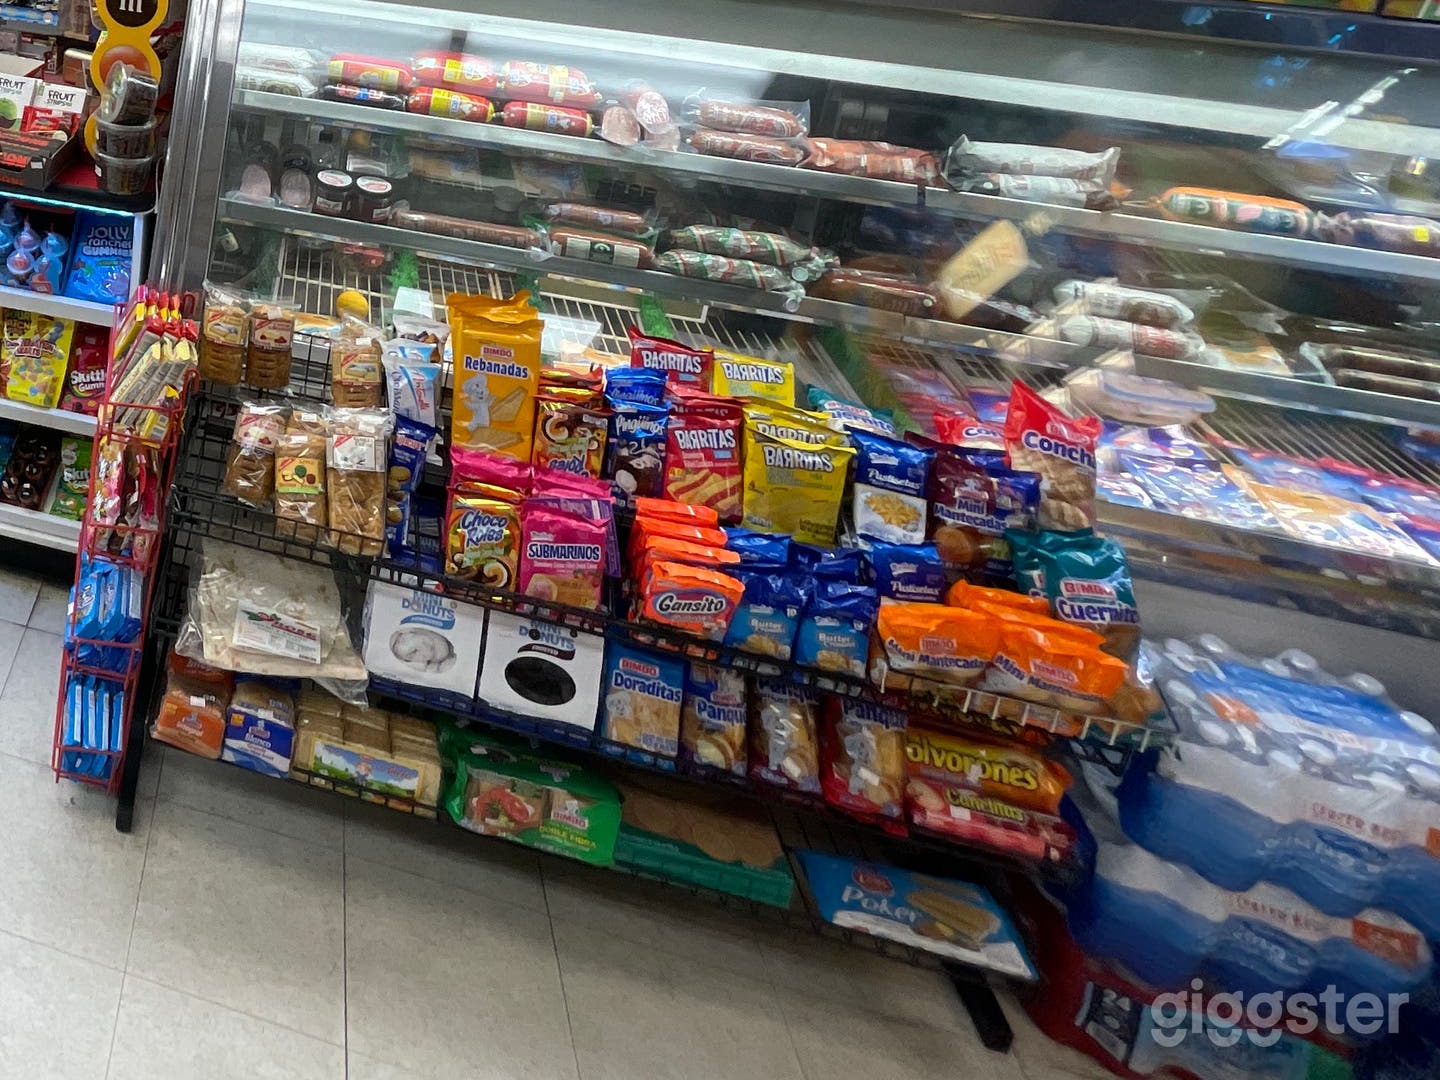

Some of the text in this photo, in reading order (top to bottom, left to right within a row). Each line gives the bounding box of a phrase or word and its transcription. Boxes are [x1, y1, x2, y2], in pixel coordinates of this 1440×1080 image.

[47, 89, 77, 103] FRUIT
[87, 225, 130, 241] JOLLY
[82, 244, 132, 258] GUMMIE
[464, 356, 529, 379] Rebanadas
[70, 369, 106, 386] Skittl
[957, 498, 987, 515] Mini
[460, 510, 508, 530] Choco
[934, 502, 1009, 532] Mantecadas
[528, 543, 601, 561] SUBMARINOS
[412, 590, 443, 607] MINI
[657, 595, 727, 614] Gansito
[401, 598, 456, 620] DONUTS
[518, 625, 576, 650] DONUTS
[620, 659, 660, 676] BIMBO
[613, 671, 682, 704] Doraditas
[696, 697, 747, 724] Panqu
[244, 733, 272, 749] Blanco
[907, 741, 1039, 791] olvorones
